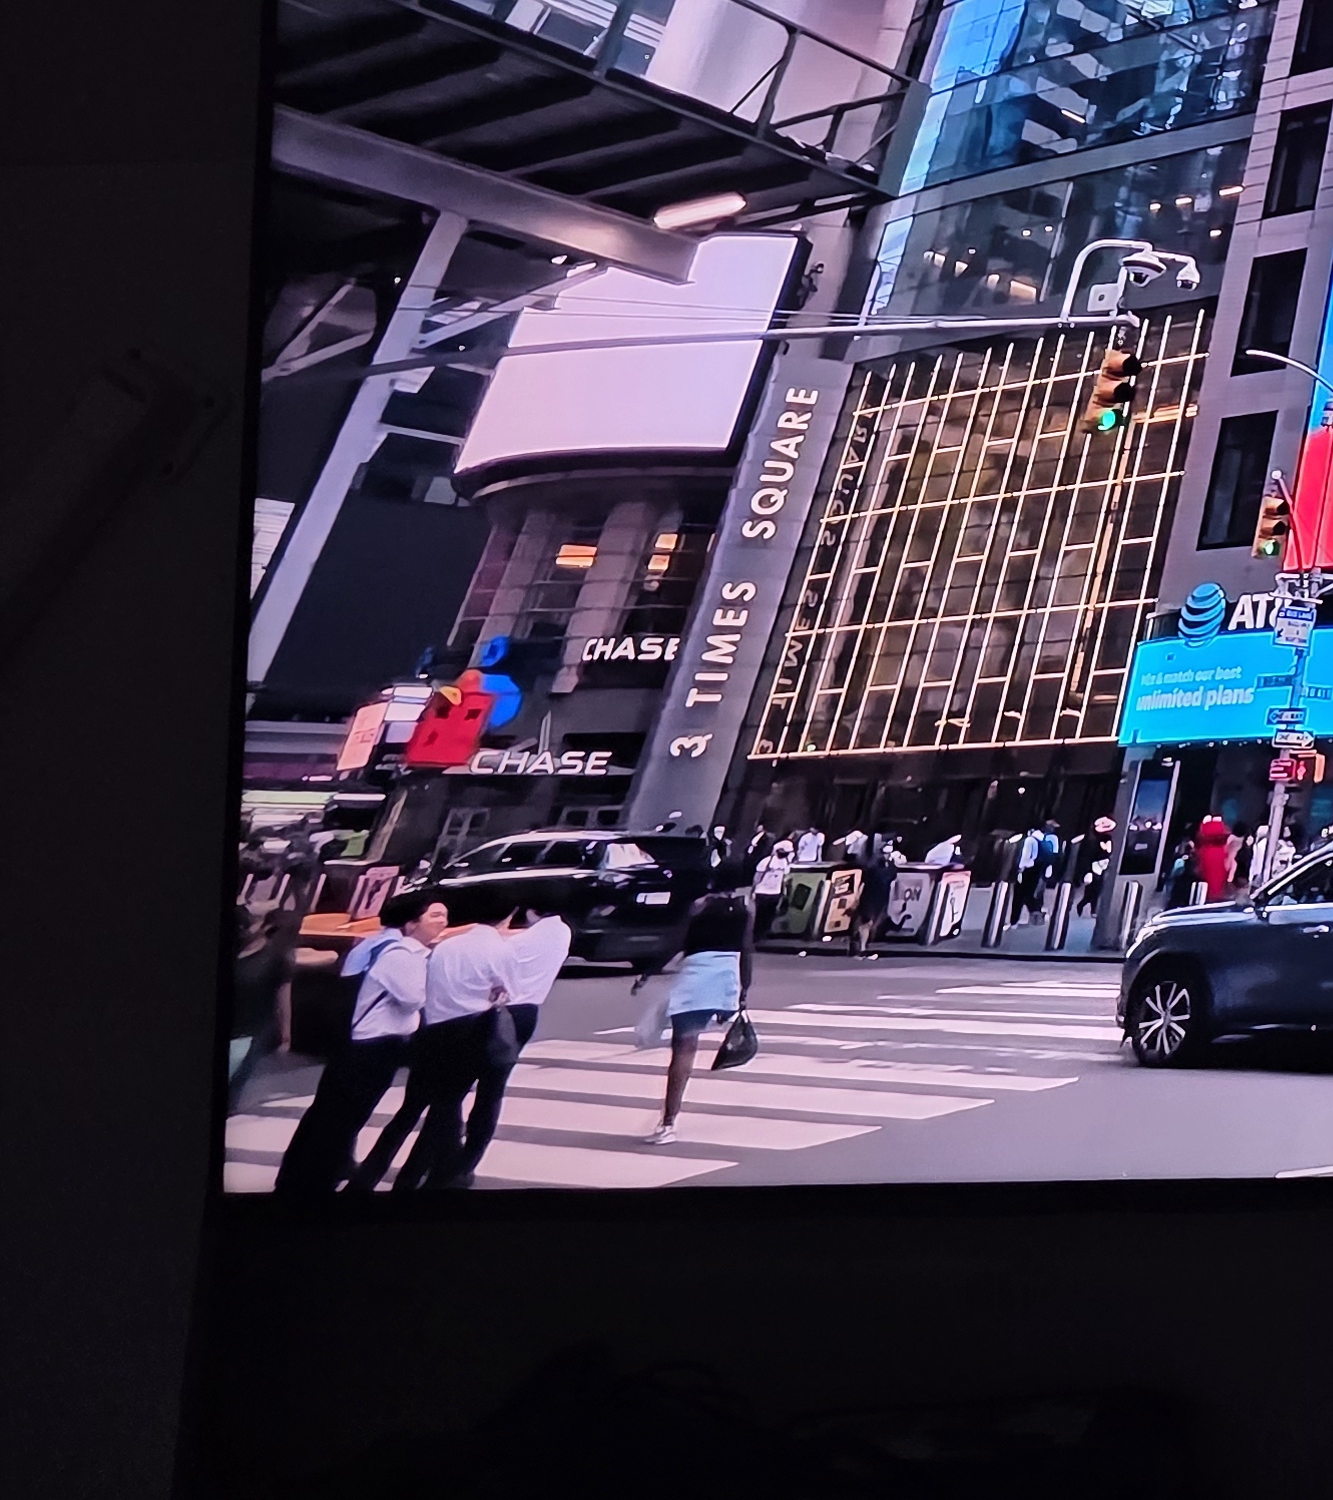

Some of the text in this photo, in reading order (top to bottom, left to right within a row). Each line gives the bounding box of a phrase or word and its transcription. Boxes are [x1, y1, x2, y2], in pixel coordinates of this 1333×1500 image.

[670, 387, 819, 758] 3 TIMES SQUARE
[582, 637, 680, 661] CHASE
[1136, 684, 1255, 711] unlimited plans
[470, 751, 612, 775] CHASE
